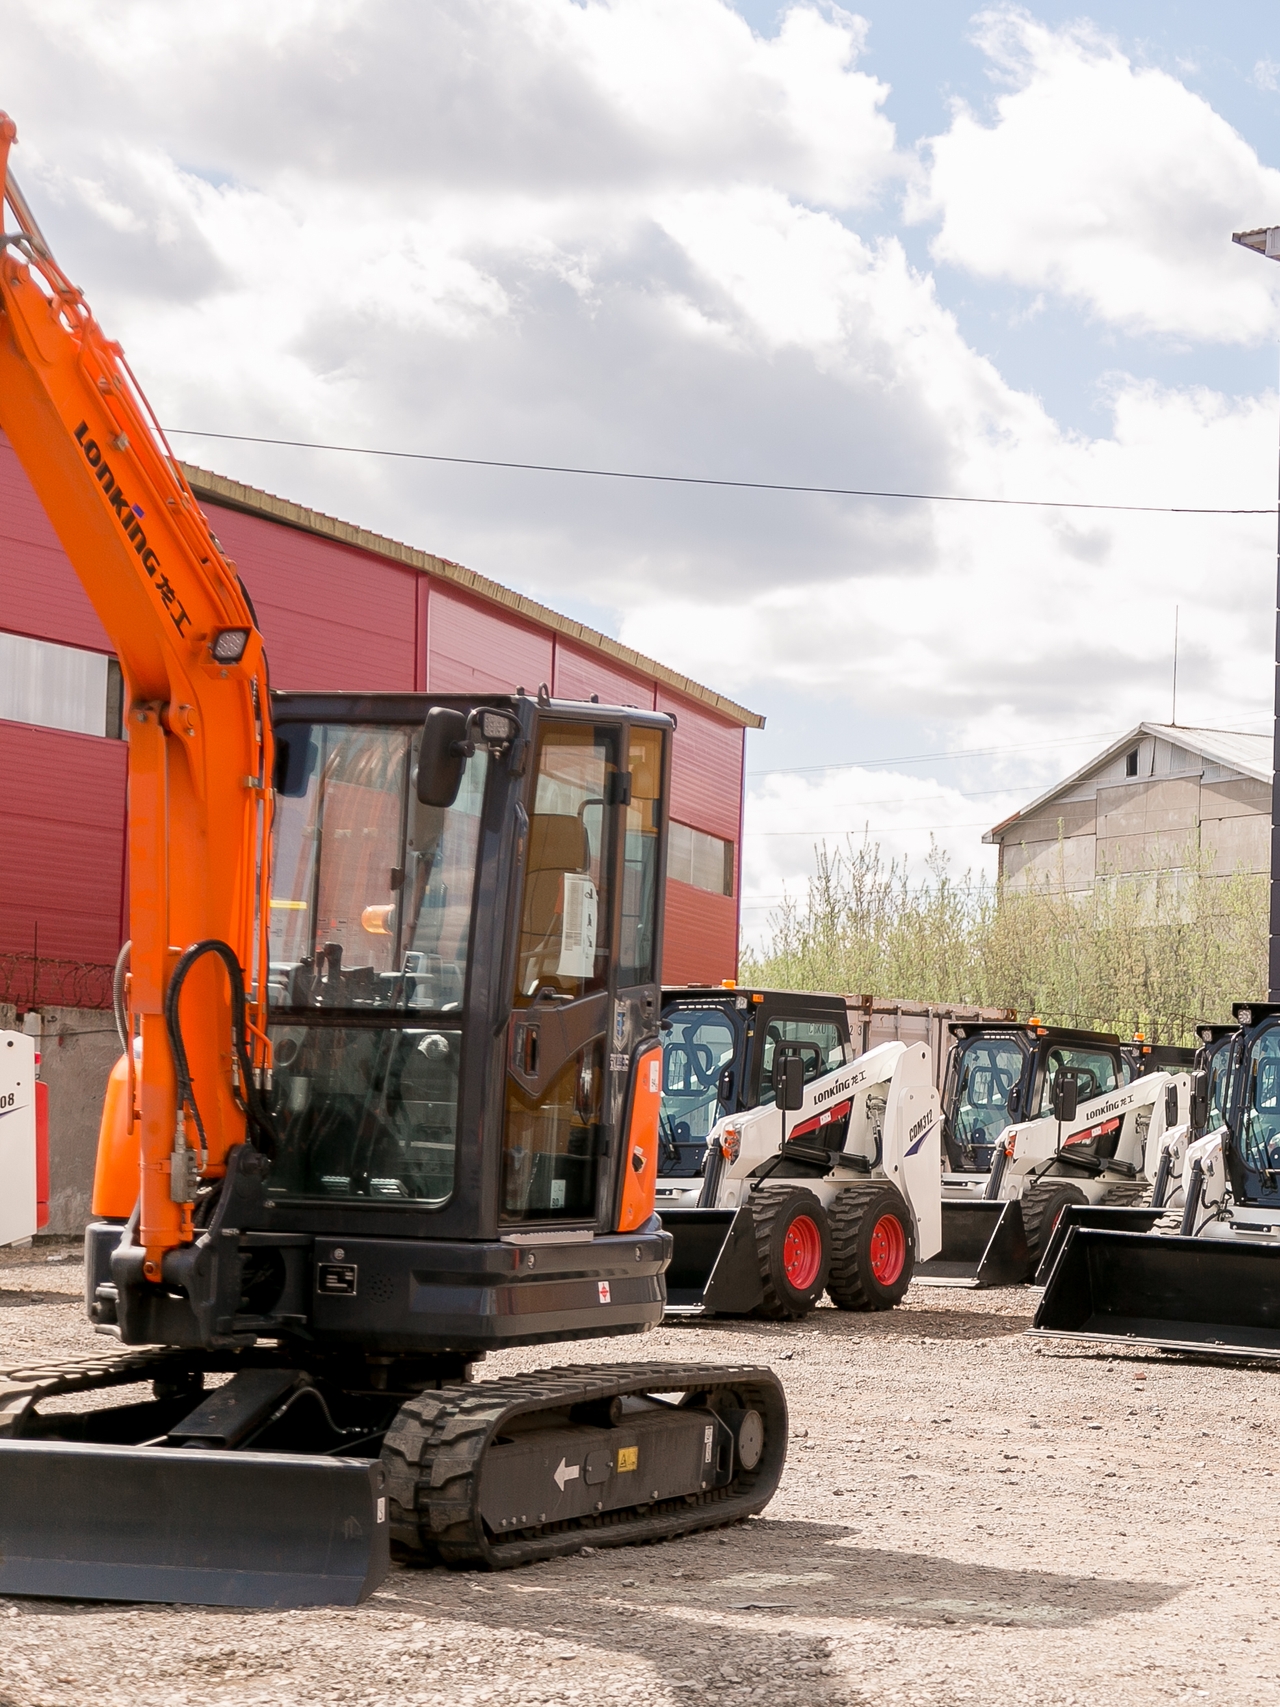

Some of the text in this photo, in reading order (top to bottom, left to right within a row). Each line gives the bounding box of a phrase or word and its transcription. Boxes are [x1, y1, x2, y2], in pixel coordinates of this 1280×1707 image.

[73, 420, 161, 578] LONKING
[813, 1078, 850, 1106] LONKING
[908, 1108, 933, 1143] CDM312
[1086, 1100, 1120, 1121] LONKING
